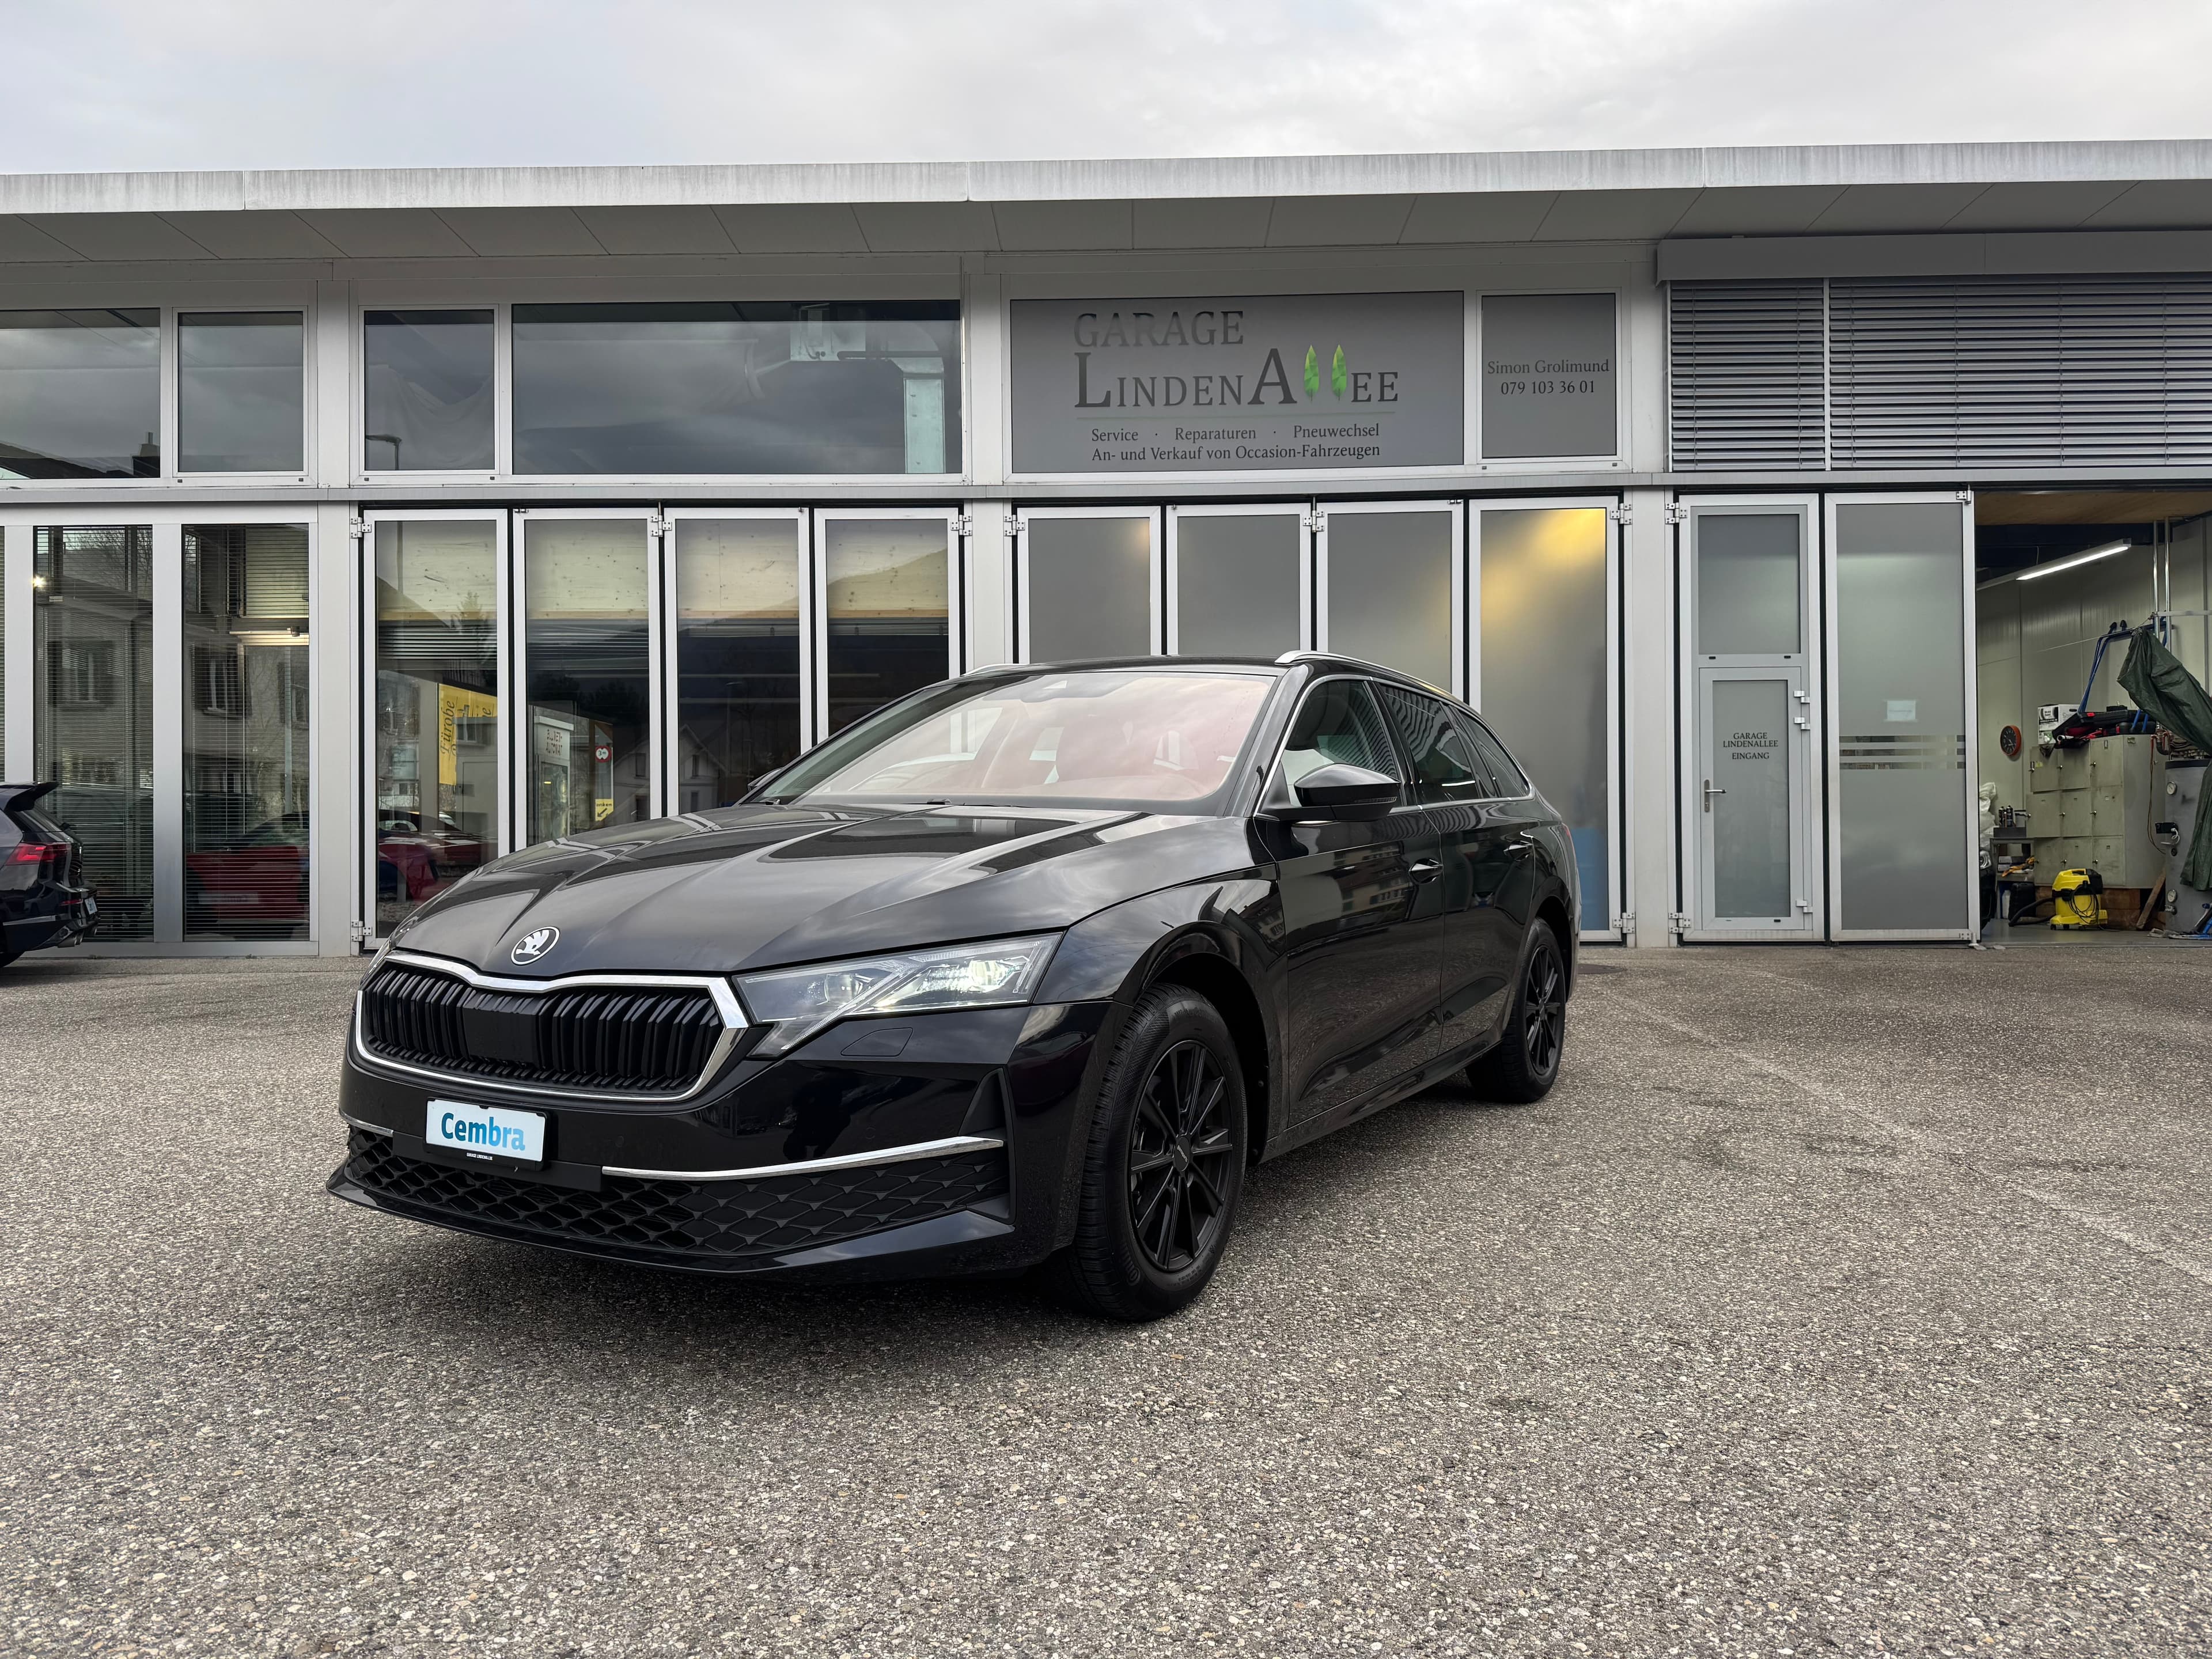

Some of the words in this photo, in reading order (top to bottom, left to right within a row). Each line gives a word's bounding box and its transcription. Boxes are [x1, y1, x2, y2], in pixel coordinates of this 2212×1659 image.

[1074, 310, 1244, 347] GARAGE
[1487, 361, 1530, 374] Simon
[1535, 359, 1610, 373] Grolimund
[1501, 381, 1525, 395] 079
[1532, 381, 1554, 394] 103
[1559, 380, 1575, 393] 36
[1580, 380, 1594, 393] 01
[1092, 428, 1139, 442] Service
[1175, 427, 1256, 444] Reparaturen
[1293, 423, 1379, 438] Pneuwechsel
[1092, 448, 1116, 461] An-
[1120, 447, 1146, 460] und
[1150, 446, 1204, 460] Verkauf
[1207, 449, 1231, 459] von
[1236, 444, 1380, 460] Occasion-Fahrzeugen
[441, 1112, 526, 1151] Cembra
